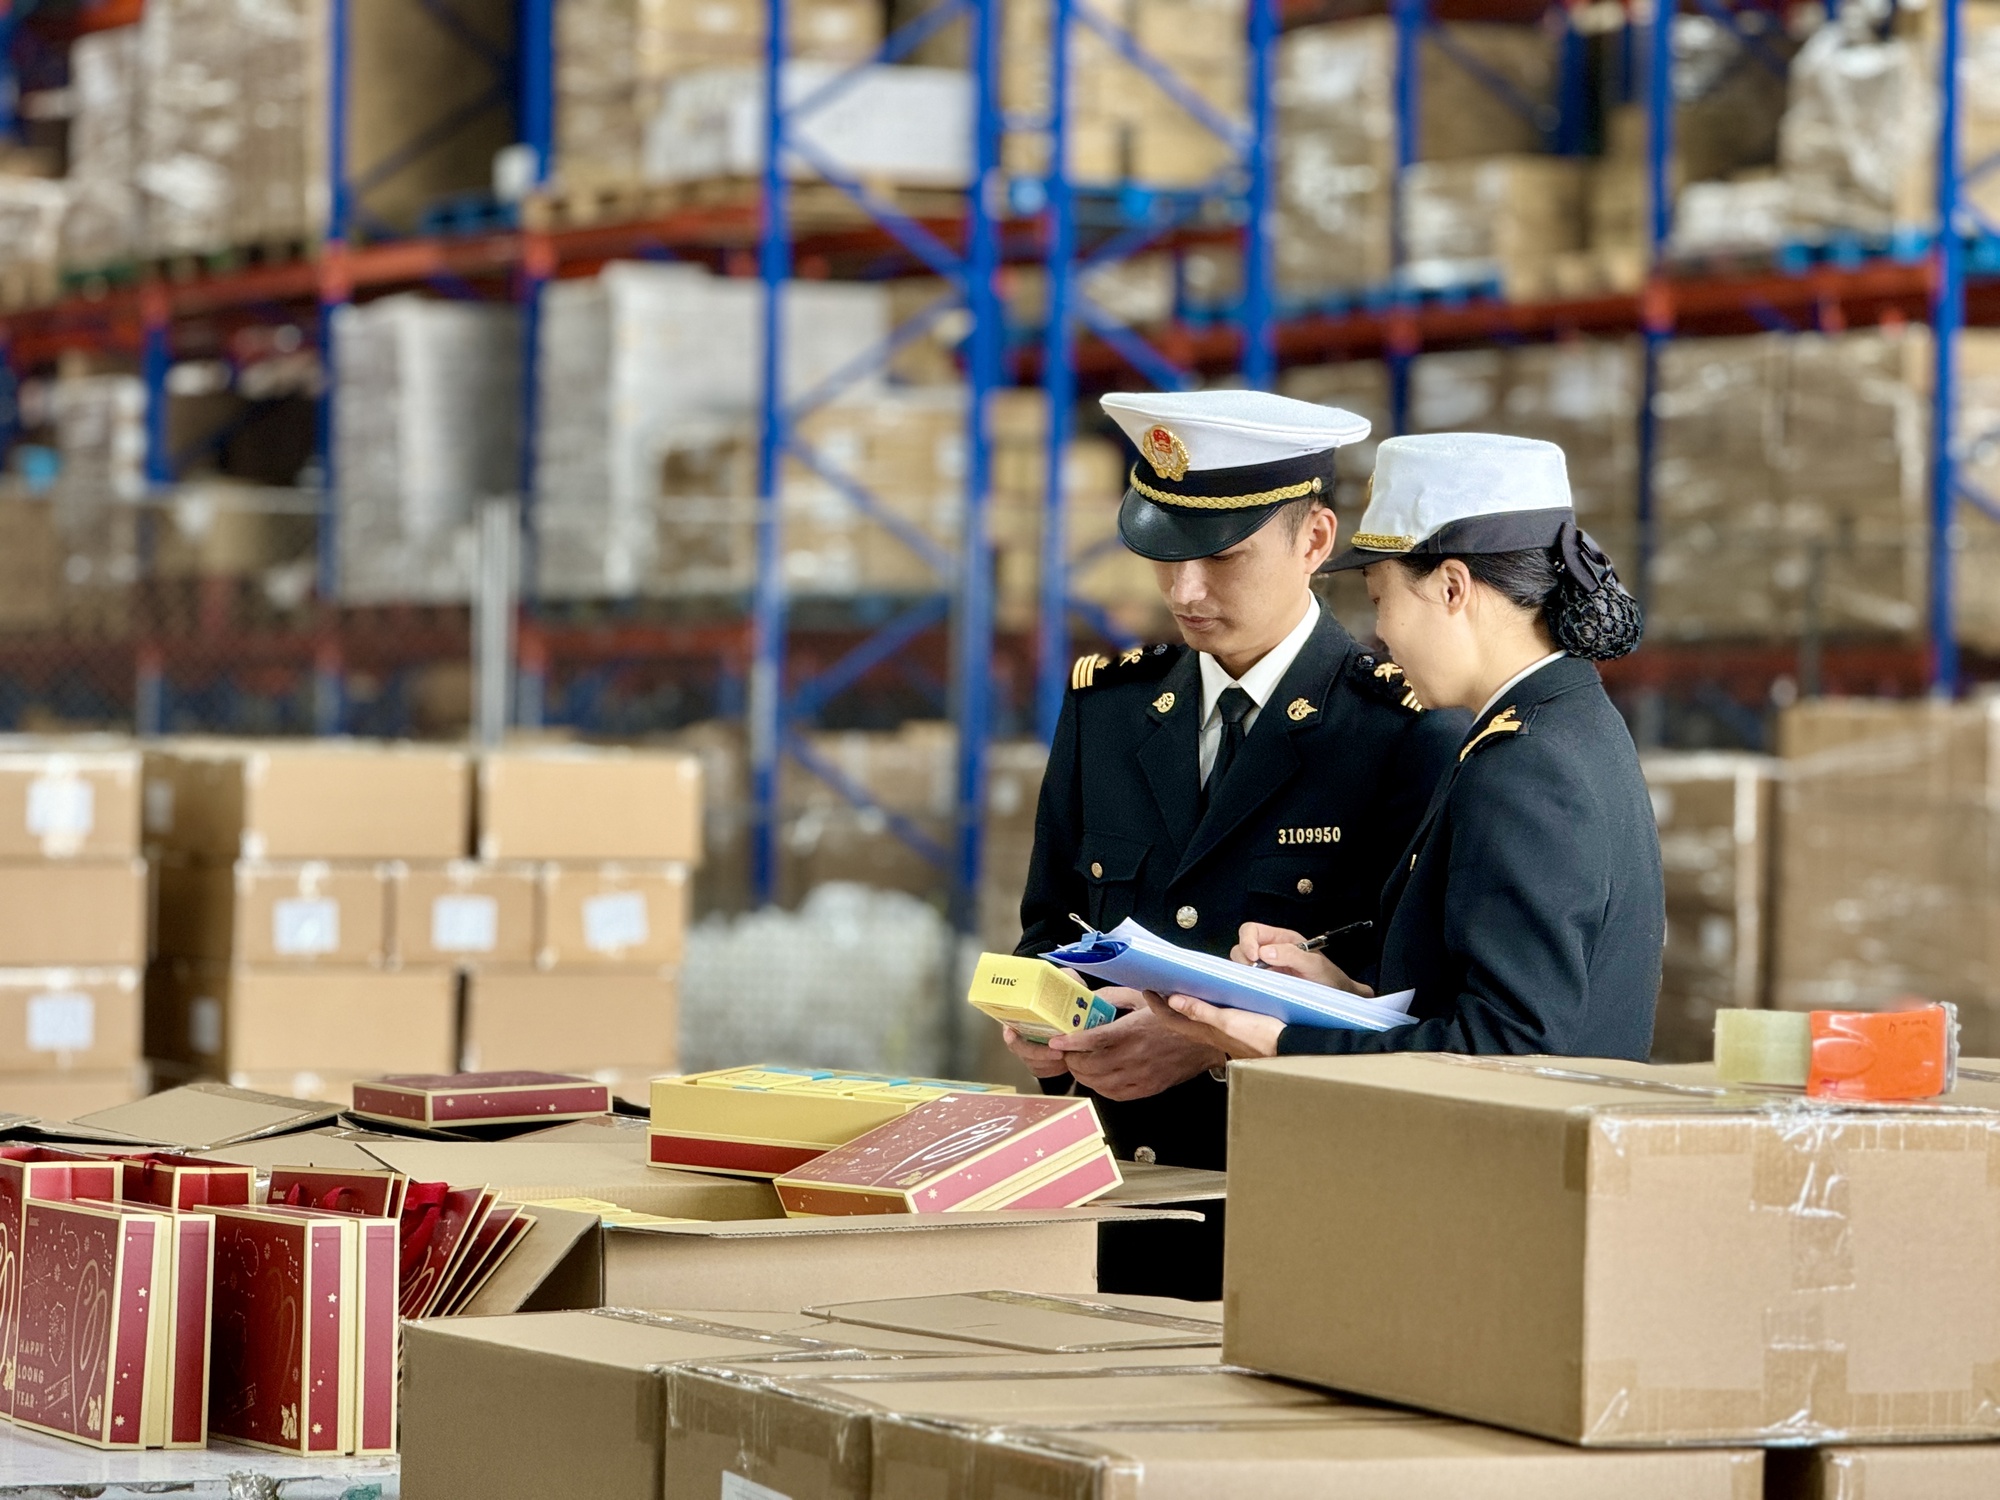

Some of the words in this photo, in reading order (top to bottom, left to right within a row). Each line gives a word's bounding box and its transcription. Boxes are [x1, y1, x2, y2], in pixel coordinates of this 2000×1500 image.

[1278, 826, 1341, 845] 3109950
[19, 1340, 44, 1358] HAPPY
[17, 1364, 44, 1384] LOONG
